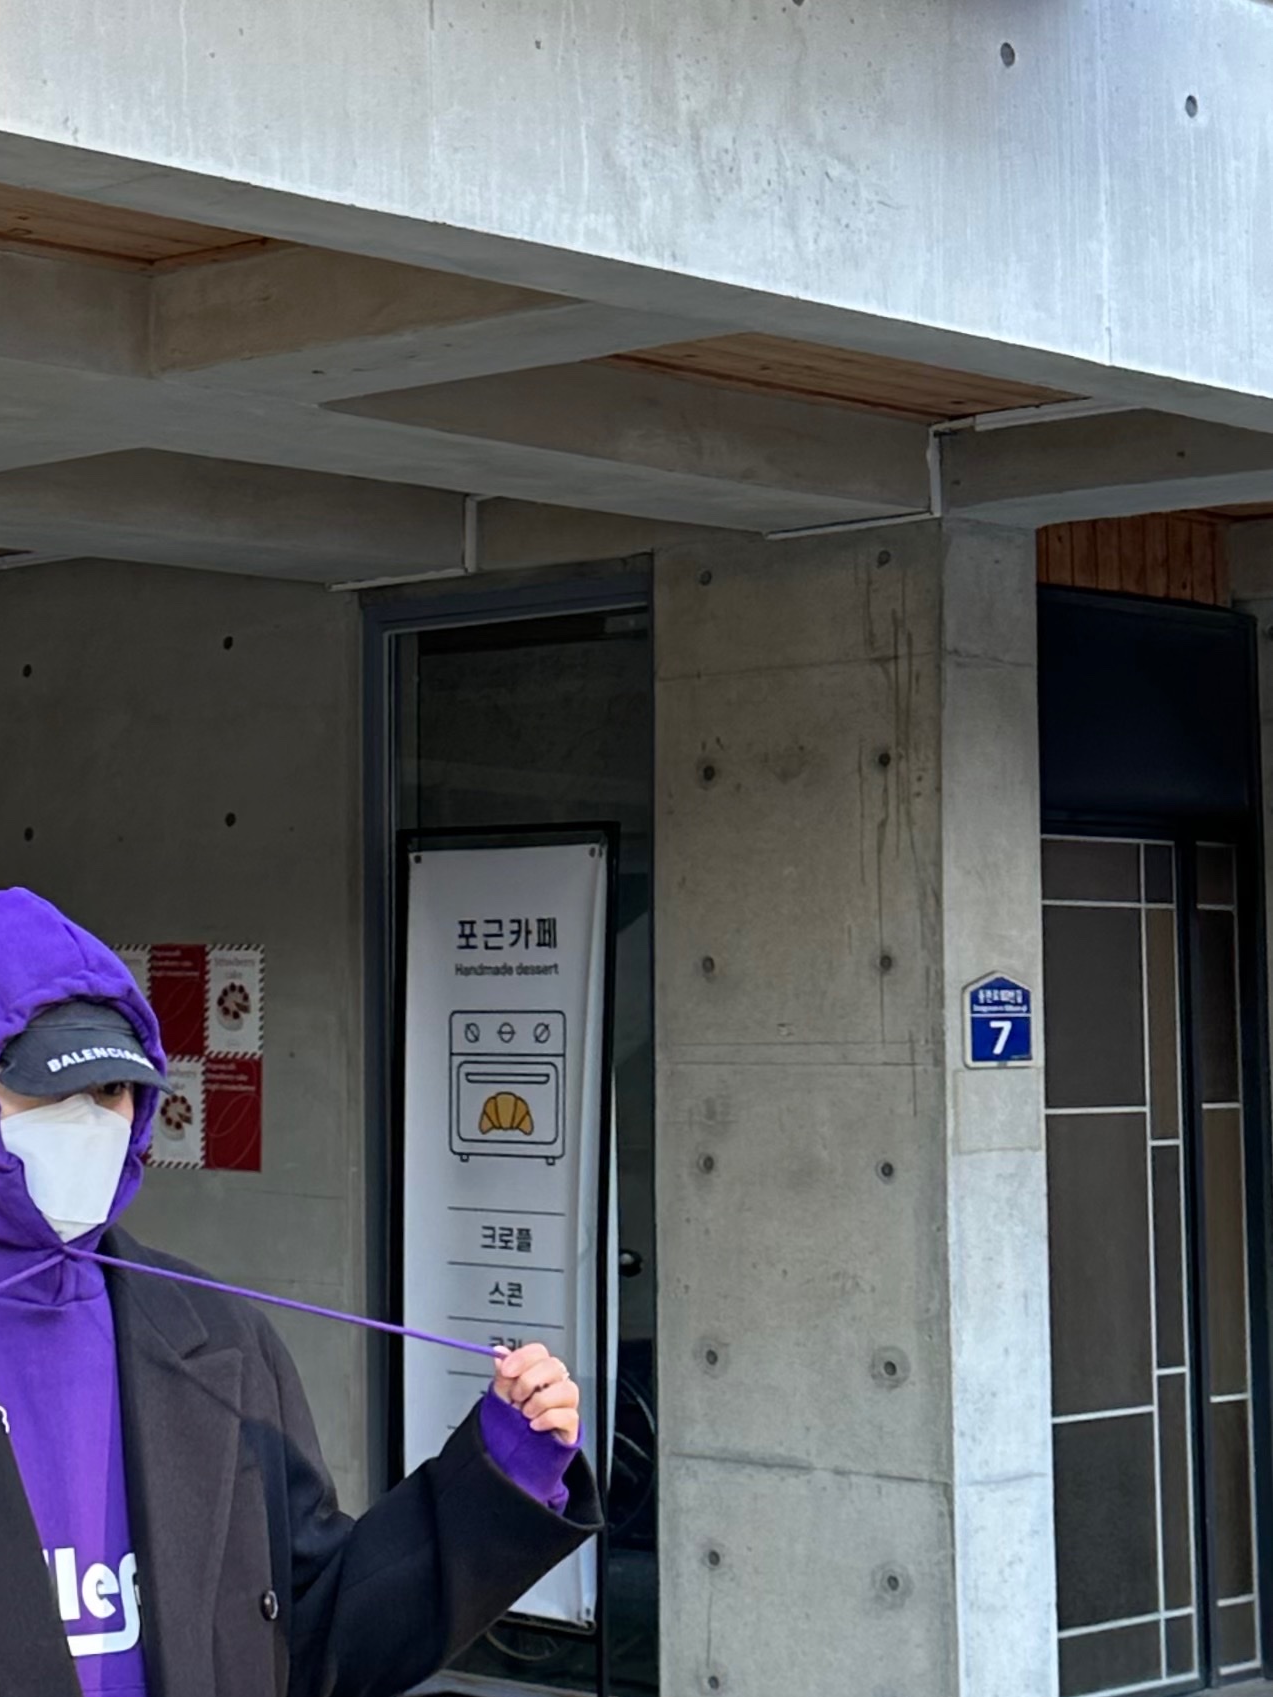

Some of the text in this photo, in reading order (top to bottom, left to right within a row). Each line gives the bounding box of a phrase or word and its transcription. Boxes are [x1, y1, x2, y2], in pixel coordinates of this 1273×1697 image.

[457, 917, 558, 950] 포근카페
[455, 962, 559, 977] Handmade dessert
[989, 1020, 1012, 1055] 7
[480, 1225, 533, 1253] 크로플
[488, 1281, 523, 1308] 스콘
